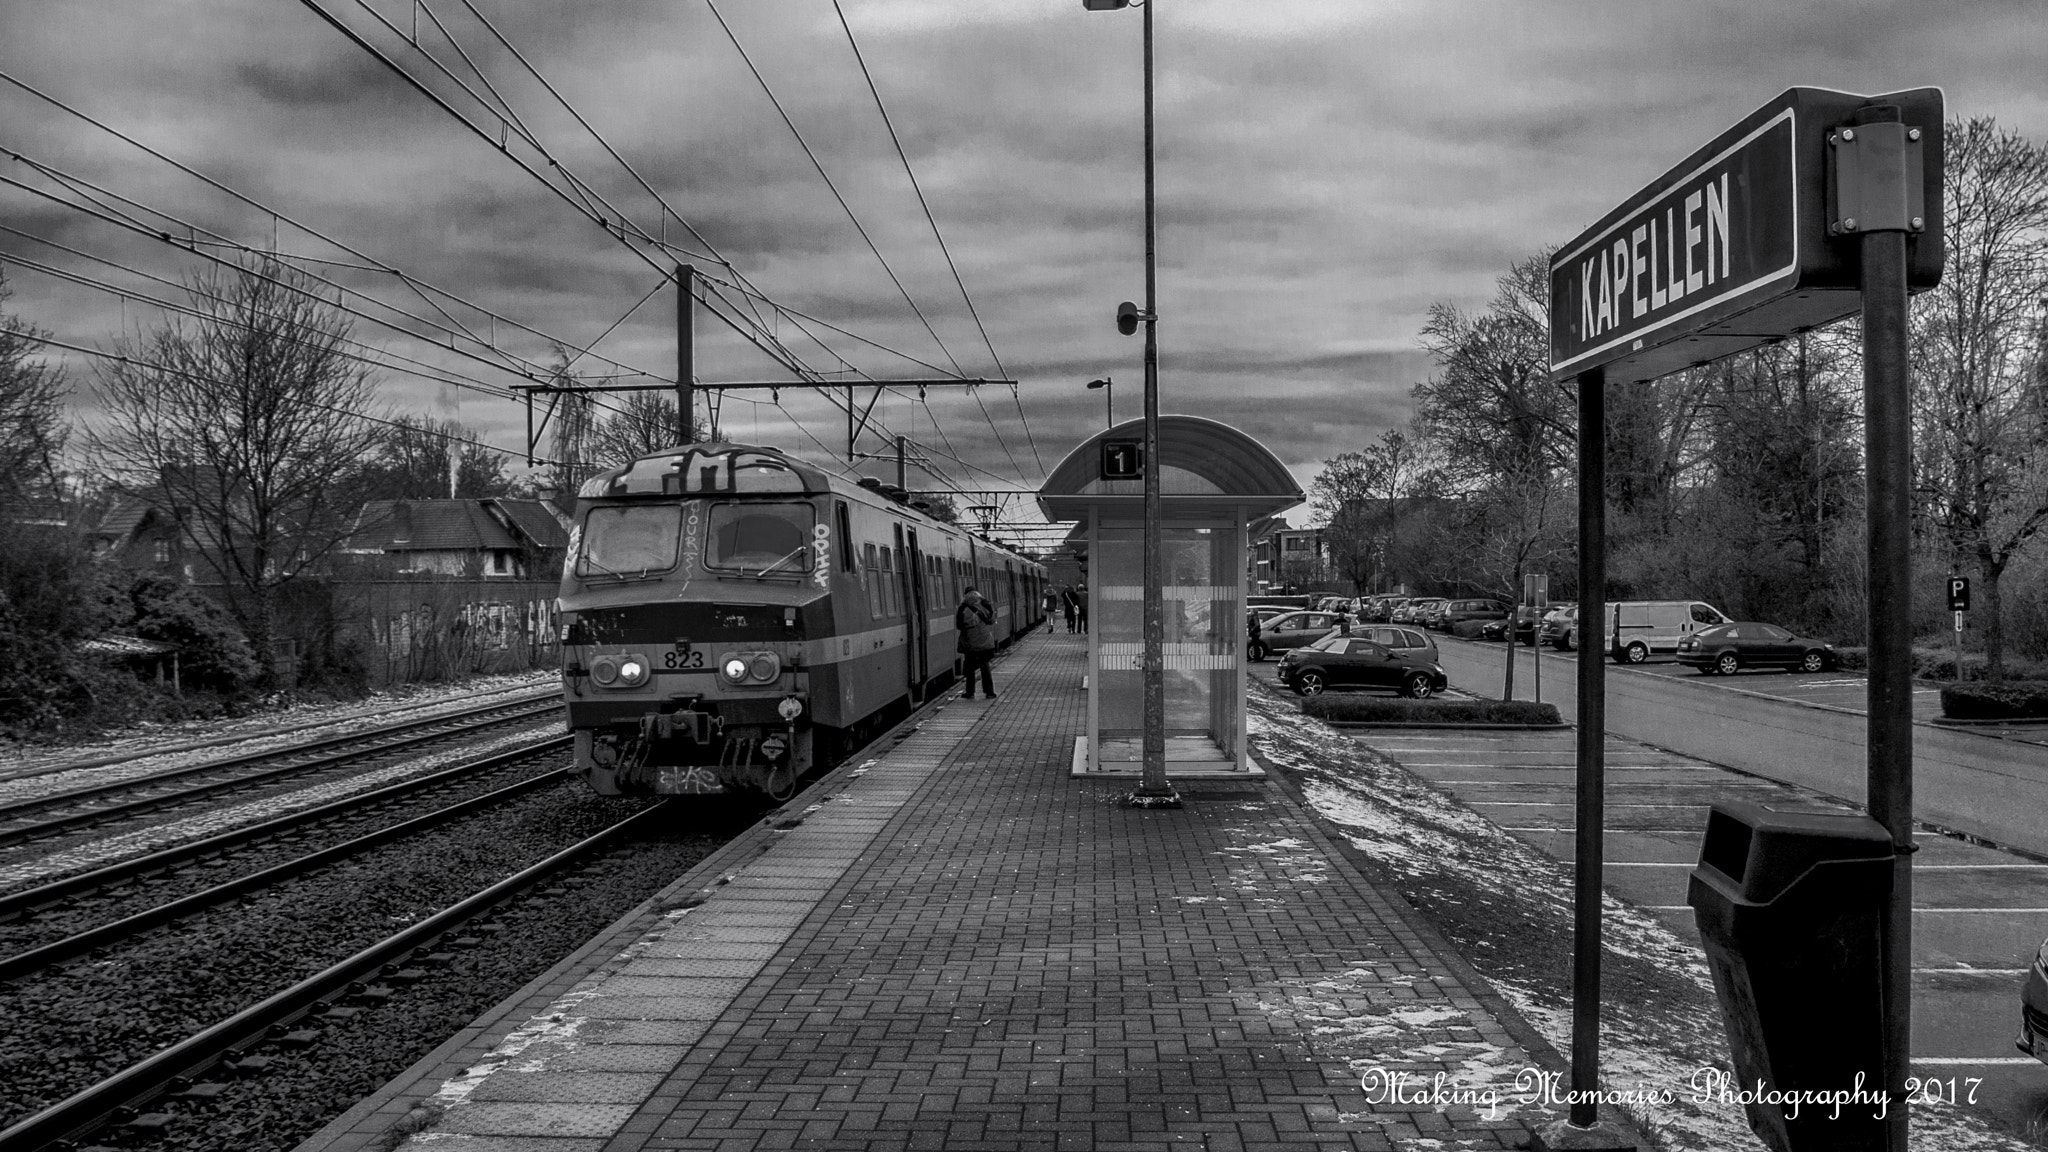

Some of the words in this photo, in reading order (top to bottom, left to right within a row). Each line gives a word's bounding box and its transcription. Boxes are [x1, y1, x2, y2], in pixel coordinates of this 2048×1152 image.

[1581, 172, 1730, 342] KAPELLEN
[1114, 451, 1125, 473] 1
[1952, 580, 1965, 598] P
[664, 651, 704, 669] 823
